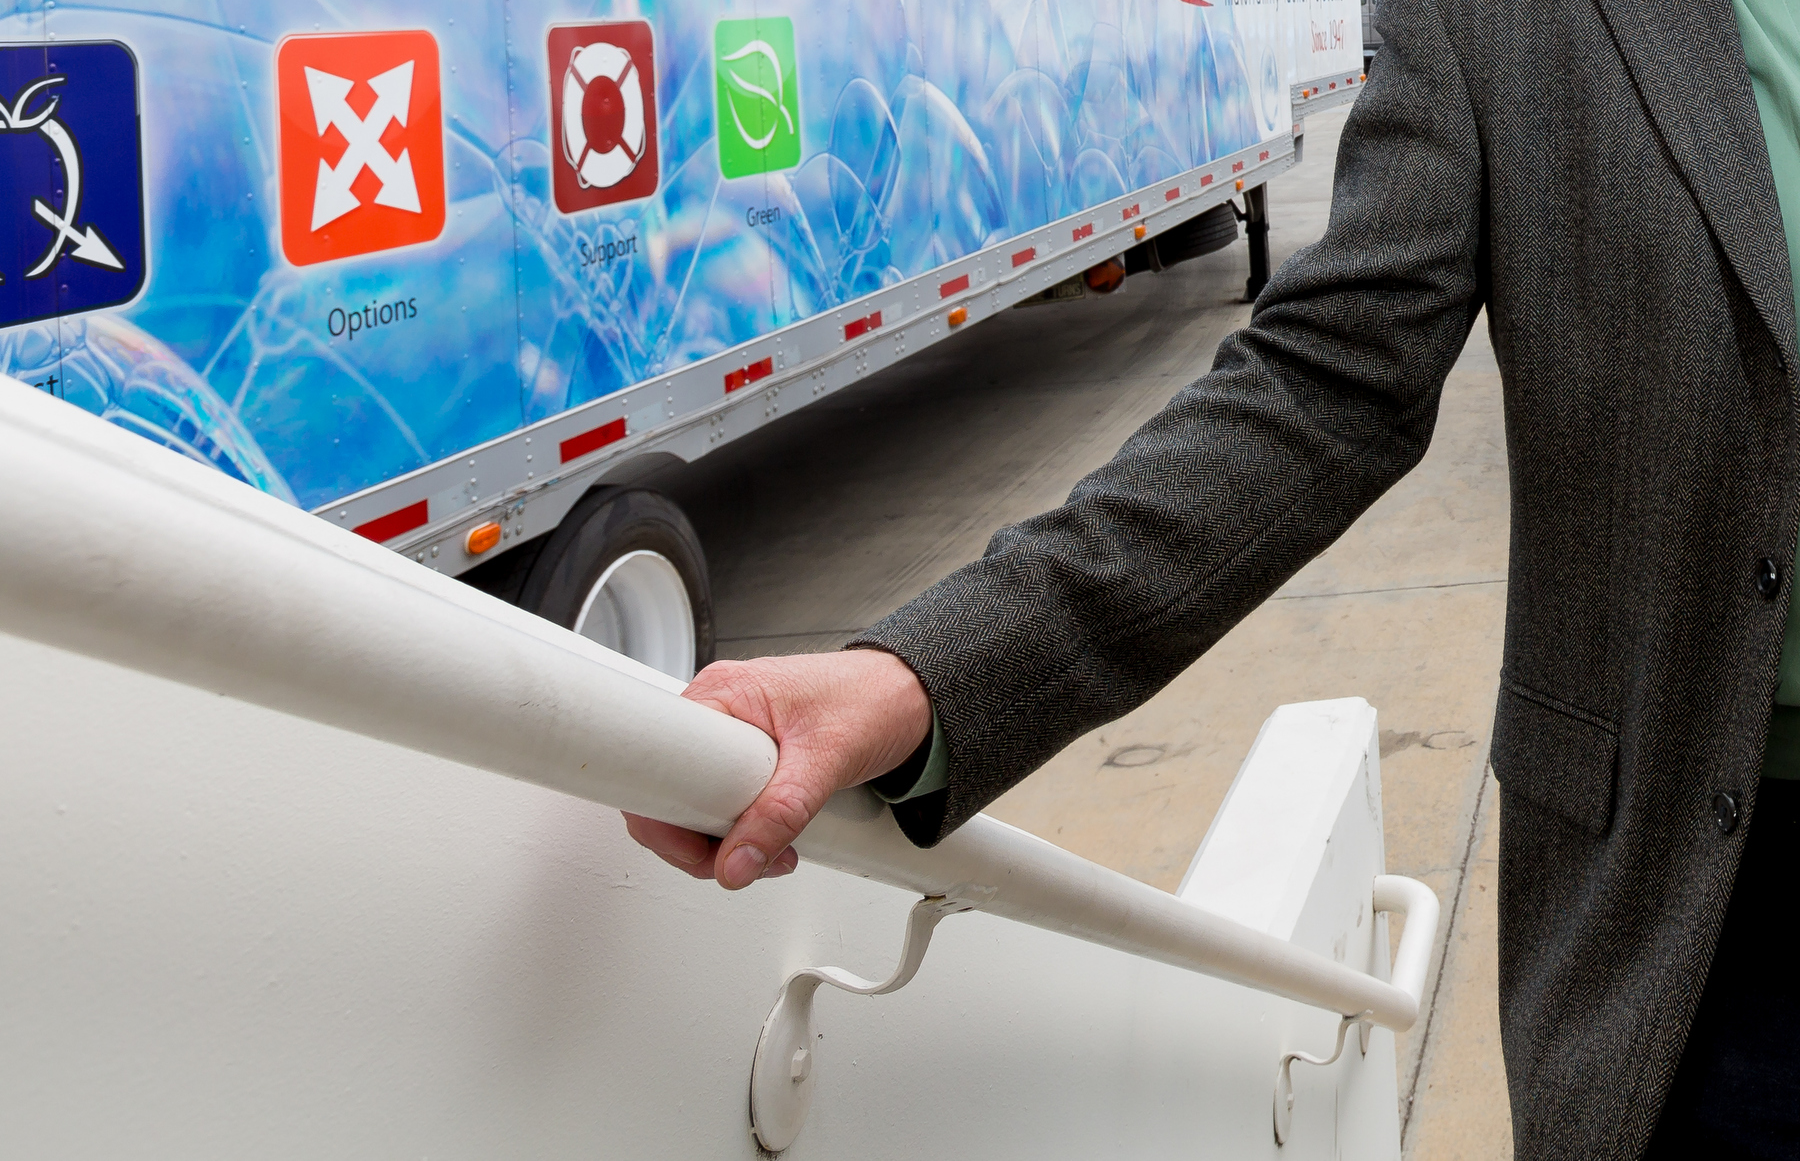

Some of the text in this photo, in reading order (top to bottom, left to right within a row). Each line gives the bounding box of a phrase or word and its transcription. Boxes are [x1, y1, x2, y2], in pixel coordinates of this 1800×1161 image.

[745, 206, 781, 228] Green
[580, 235, 638, 268] Support
[328, 297, 418, 340] Options
